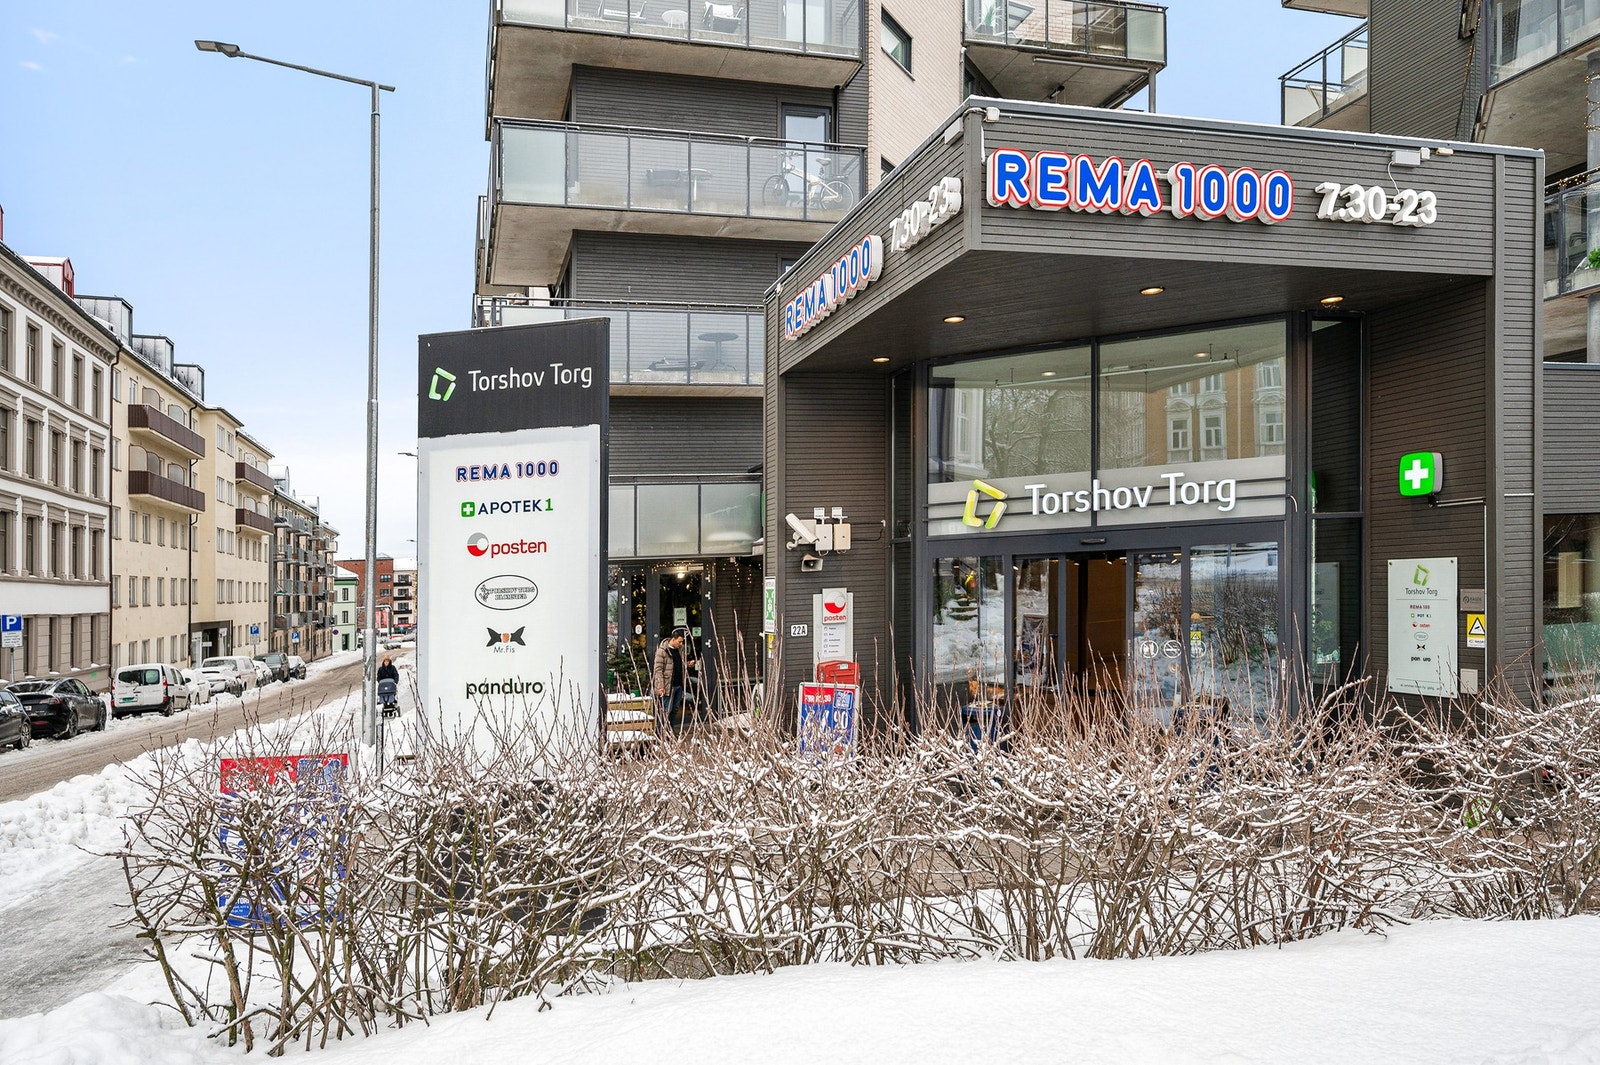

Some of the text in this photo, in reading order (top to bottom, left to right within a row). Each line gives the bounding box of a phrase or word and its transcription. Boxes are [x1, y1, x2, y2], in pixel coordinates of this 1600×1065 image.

[986, 148, 1294, 223] REMA 1000
[1315, 180, 1438, 227] 7.30-23
[784, 233, 883, 340] REMA 1000
[468, 362, 593, 393] Torshov Torg
[455, 459, 560, 483] REMA 1000
[1024, 471, 1238, 517] Torshov Torg
[477, 497, 554, 516] APOTEK 1
[490, 539, 547, 559] posten
[1426, 588, 1438, 596] Torg
[6, 616, 18, 630] P
[824, 614, 847, 622] posten
[792, 626, 807, 635] 22A
[494, 646, 515, 654] Mr.Fis
[465, 678, 544, 699] panduro
